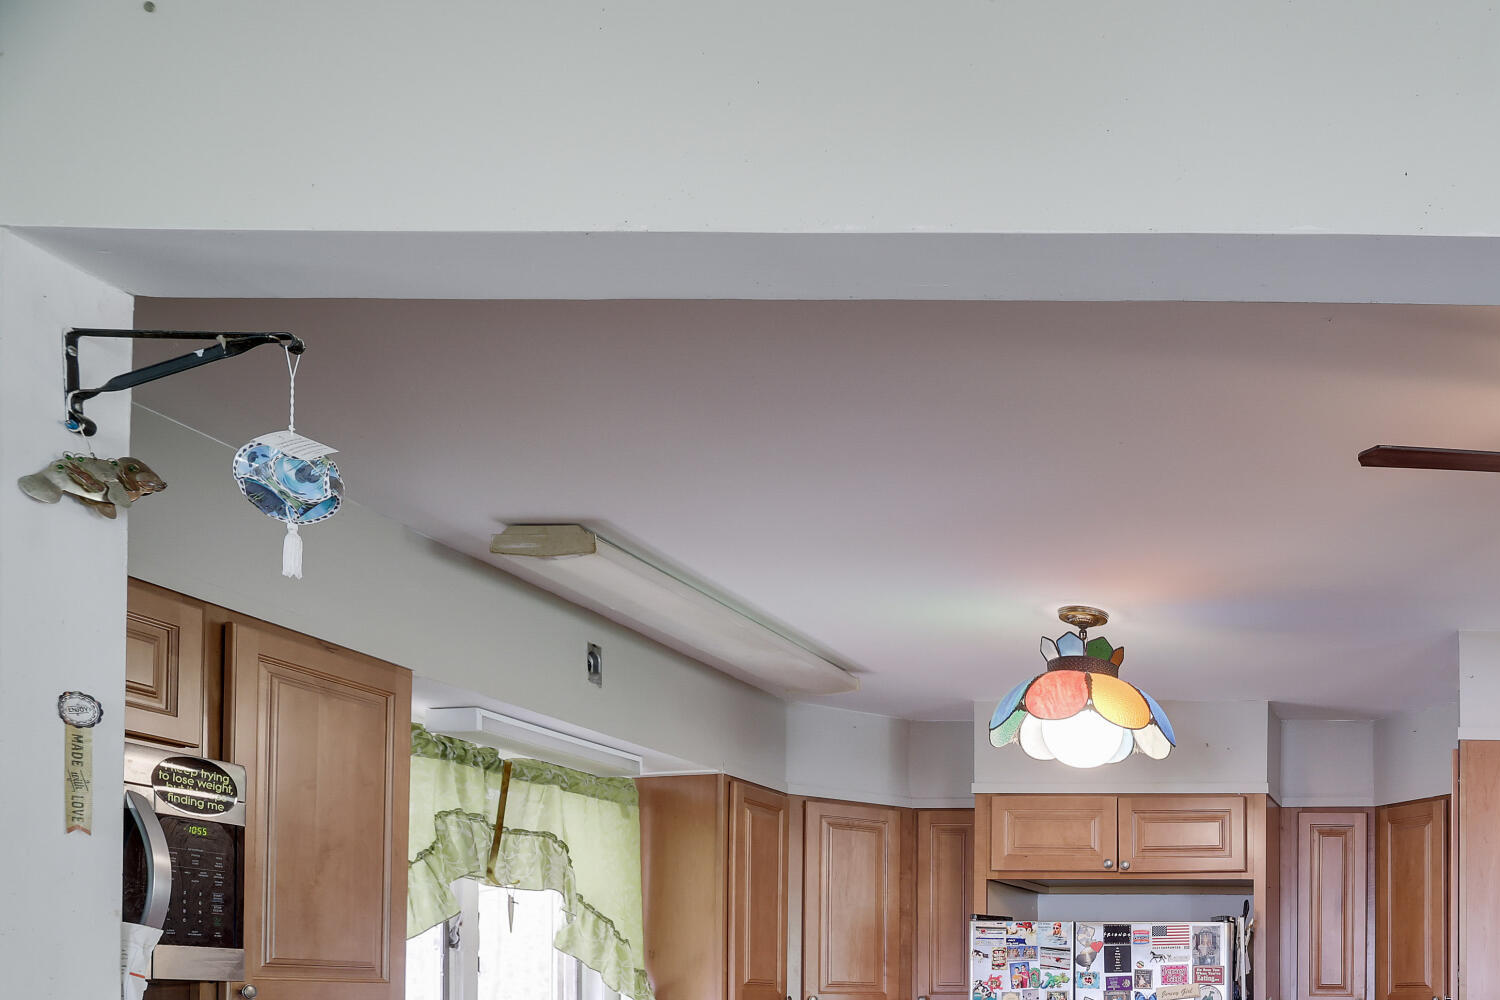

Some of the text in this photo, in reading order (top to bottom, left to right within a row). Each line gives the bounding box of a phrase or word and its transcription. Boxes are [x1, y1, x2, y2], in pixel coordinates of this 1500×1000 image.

[71, 733, 84, 767] MADE
[158, 770, 170, 780] to
[172, 773, 195, 786] lose
[197, 779, 234, 796] weight,
[200, 768, 230, 785] trying
[71, 794, 85, 824] LOVE
[167, 792, 205, 810] finding
[207, 801, 225, 812] me
